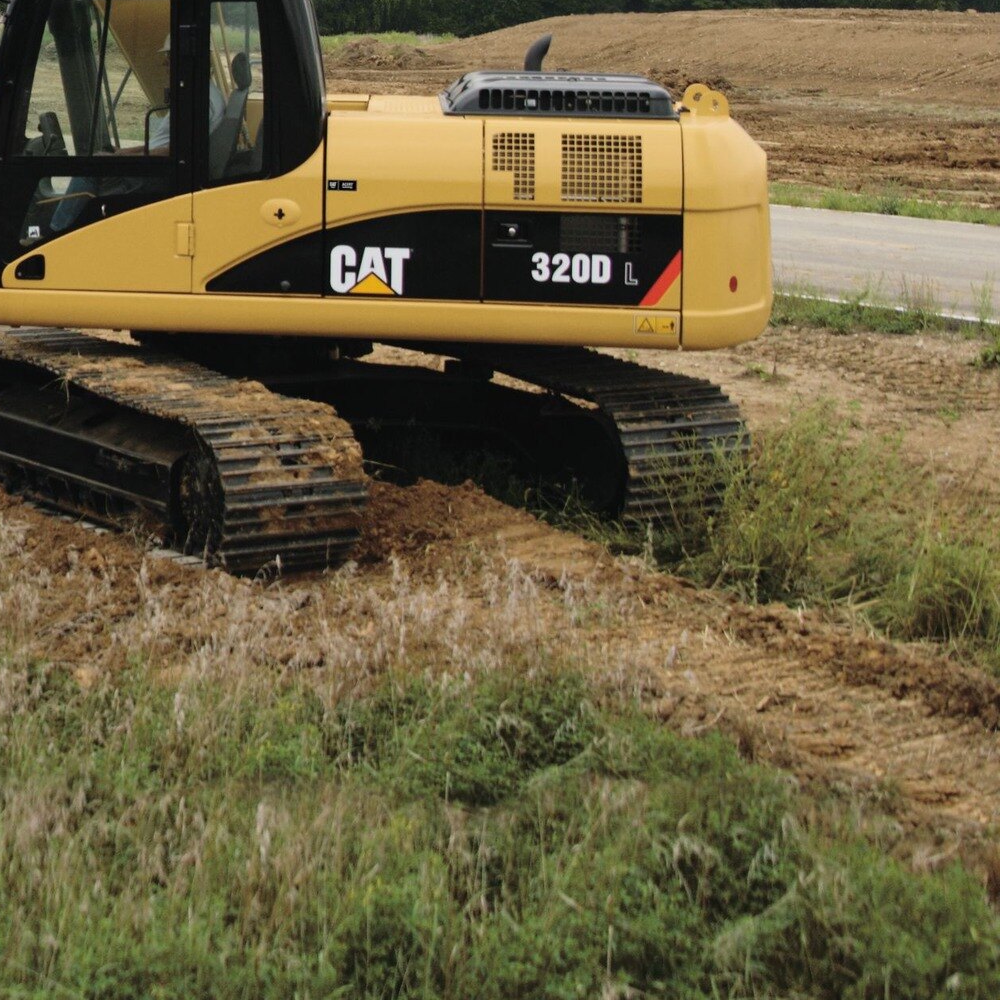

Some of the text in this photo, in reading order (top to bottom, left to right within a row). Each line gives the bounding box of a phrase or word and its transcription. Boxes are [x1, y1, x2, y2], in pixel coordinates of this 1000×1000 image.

[330, 244, 410, 296] CAT
[531, 251, 638, 285] 320D L
